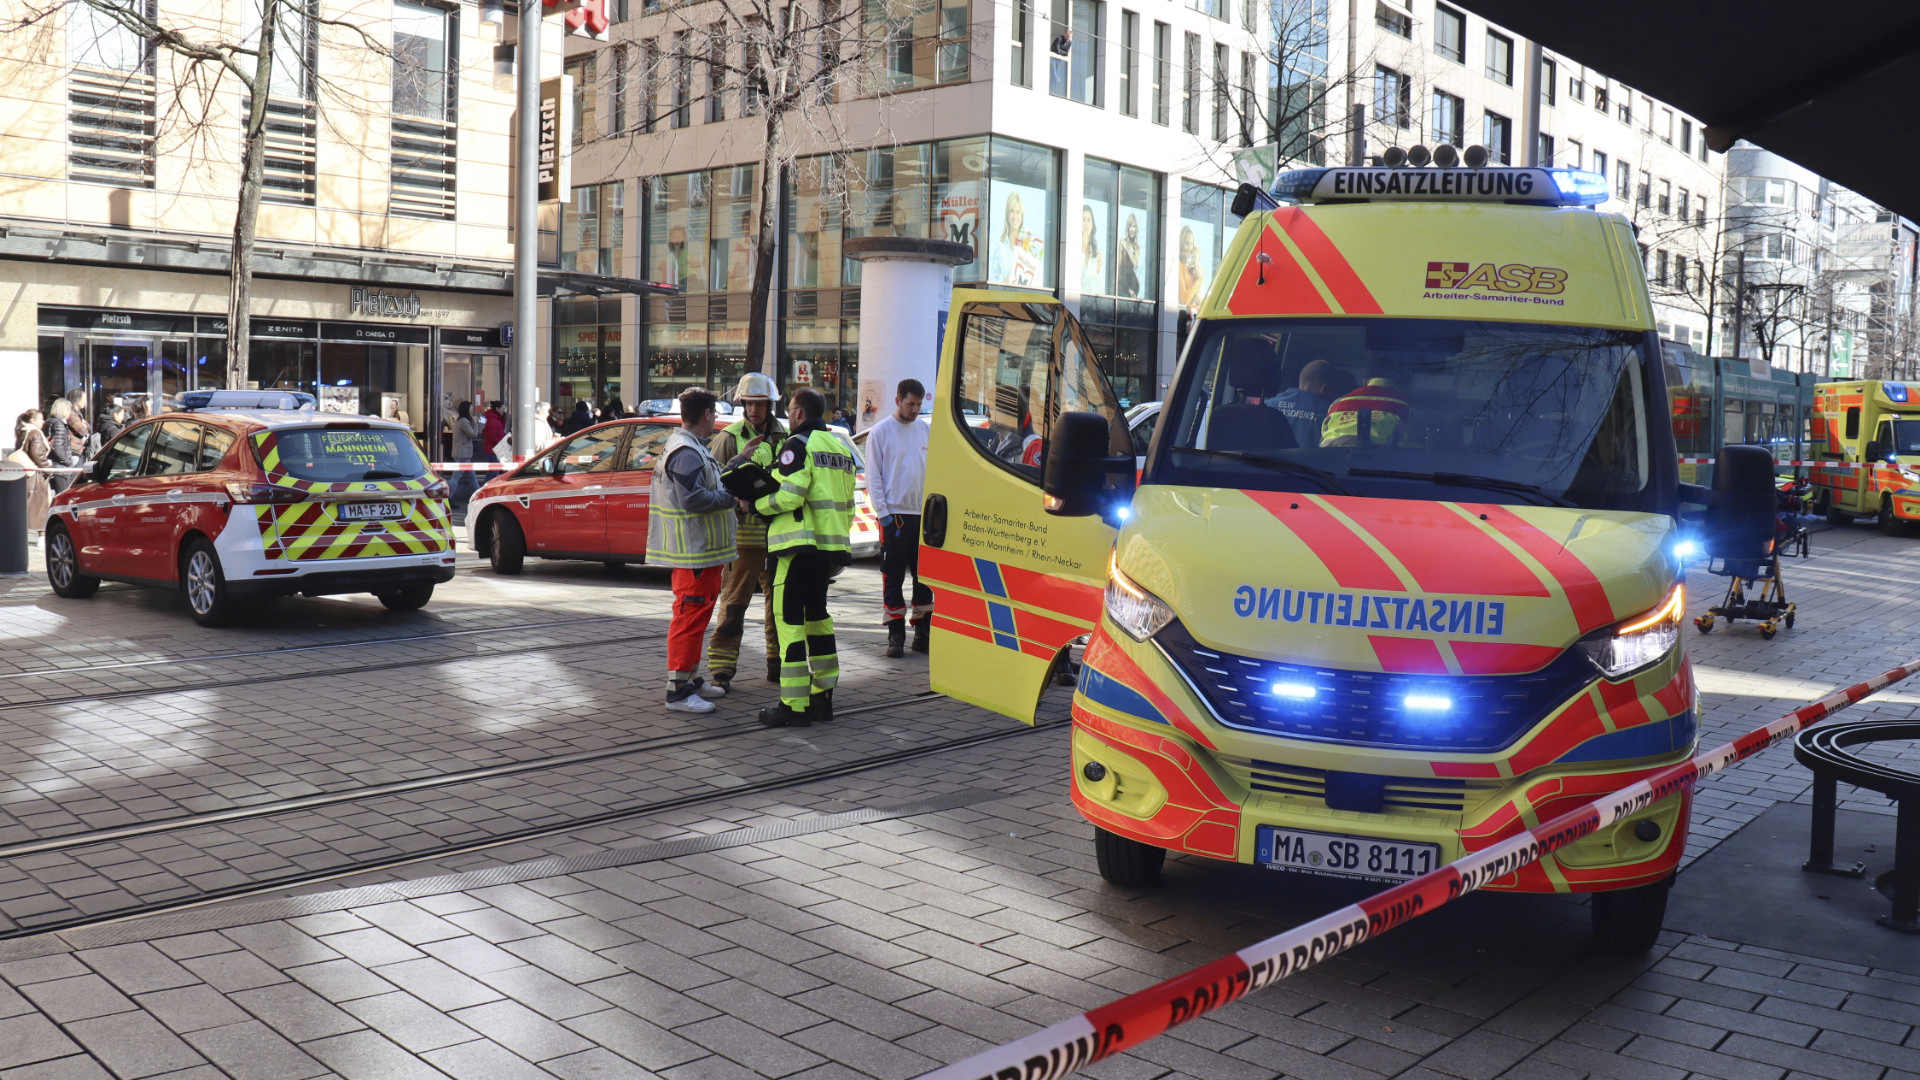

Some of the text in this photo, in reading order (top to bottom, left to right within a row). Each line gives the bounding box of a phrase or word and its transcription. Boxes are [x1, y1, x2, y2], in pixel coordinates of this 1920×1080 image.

[1334, 171, 1534, 196] EINSATZLEITUNG
[941, 195, 980, 208] Müller
[949, 222, 970, 244] M
[1017, 253, 1036, 272] Müller
[1455, 263, 1568, 295] ASB
[1422, 291, 1565, 306] Arbeiter-Samariter-Bund
[267, 325, 304, 333] ZENITH
[365, 330, 386, 338] OMEGA
[1278, 400, 1296, 409] ELW
[321, 434, 382, 443] FEUERWEHR
[325, 444, 388, 453] MANNHEIM
[356, 454, 377, 463] 112
[348, 504, 397, 517] MA F 239
[963, 508, 1048, 534] Arbeiter-Samariter-Bund
[962, 521, 1032, 547] Baden-Württemberg
[962, 534, 985, 548] Region
[986, 539, 1024, 556] Mannheim
[1031, 549, 1082, 570] Rhein-Neckar
[1261, 848, 1267, 857] D
[1273, 833, 1432, 877] MA SB 8111
[1265, 864, 1286, 872] IVECO
